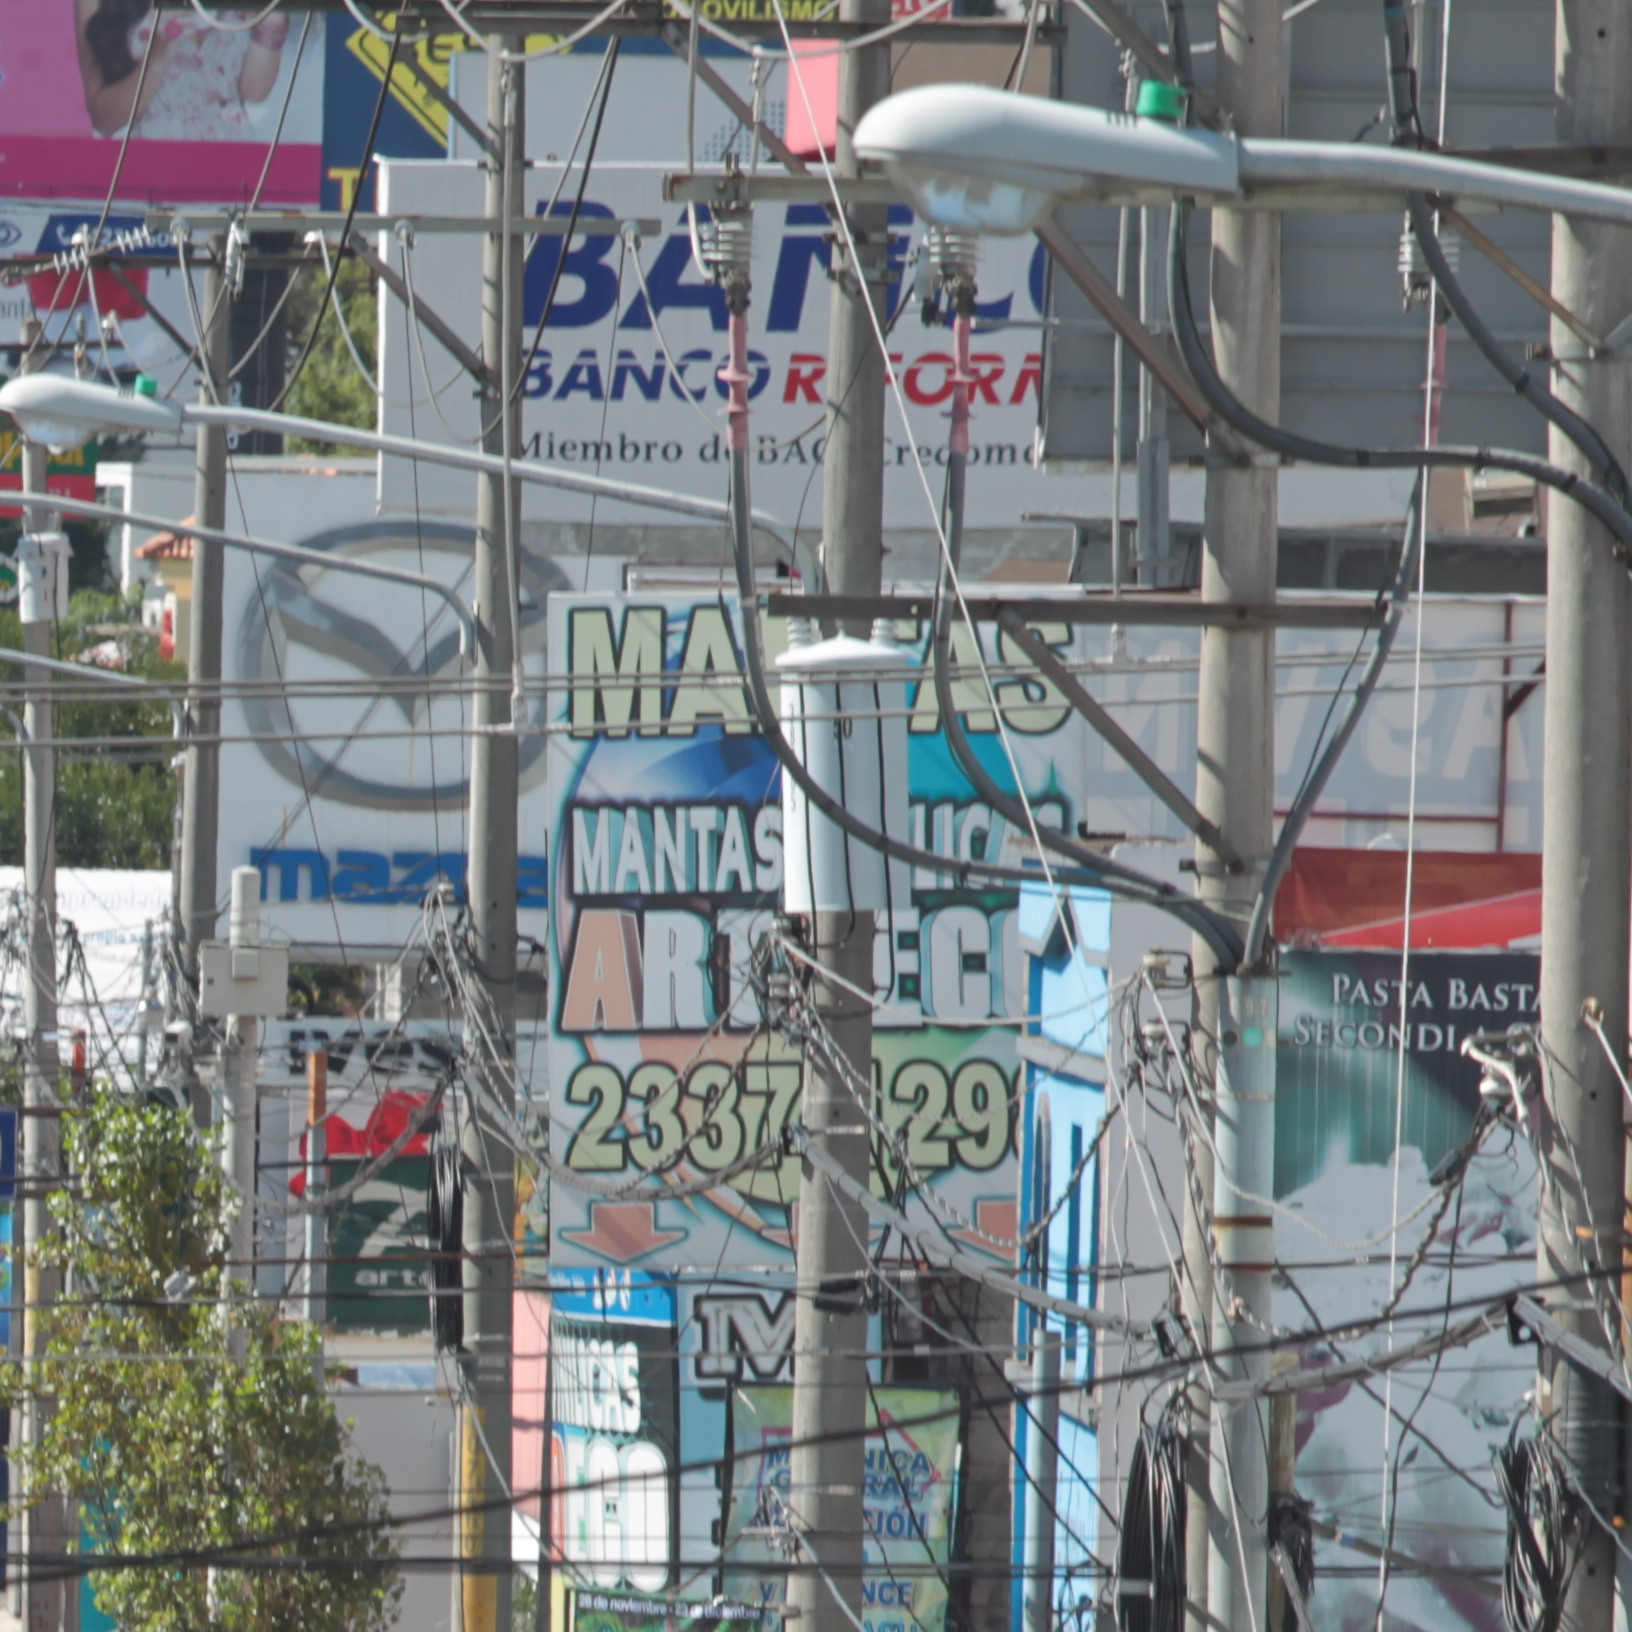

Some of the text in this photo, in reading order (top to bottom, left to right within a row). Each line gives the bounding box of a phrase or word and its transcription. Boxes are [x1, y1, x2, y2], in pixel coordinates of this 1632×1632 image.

[522, 350, 771, 403] BANCO
[1332, 973, 1434, 1010] PASTA
[1292, 1014, 1456, 1053] SECONDI
[609, 1597, 667, 1616] noviembre
